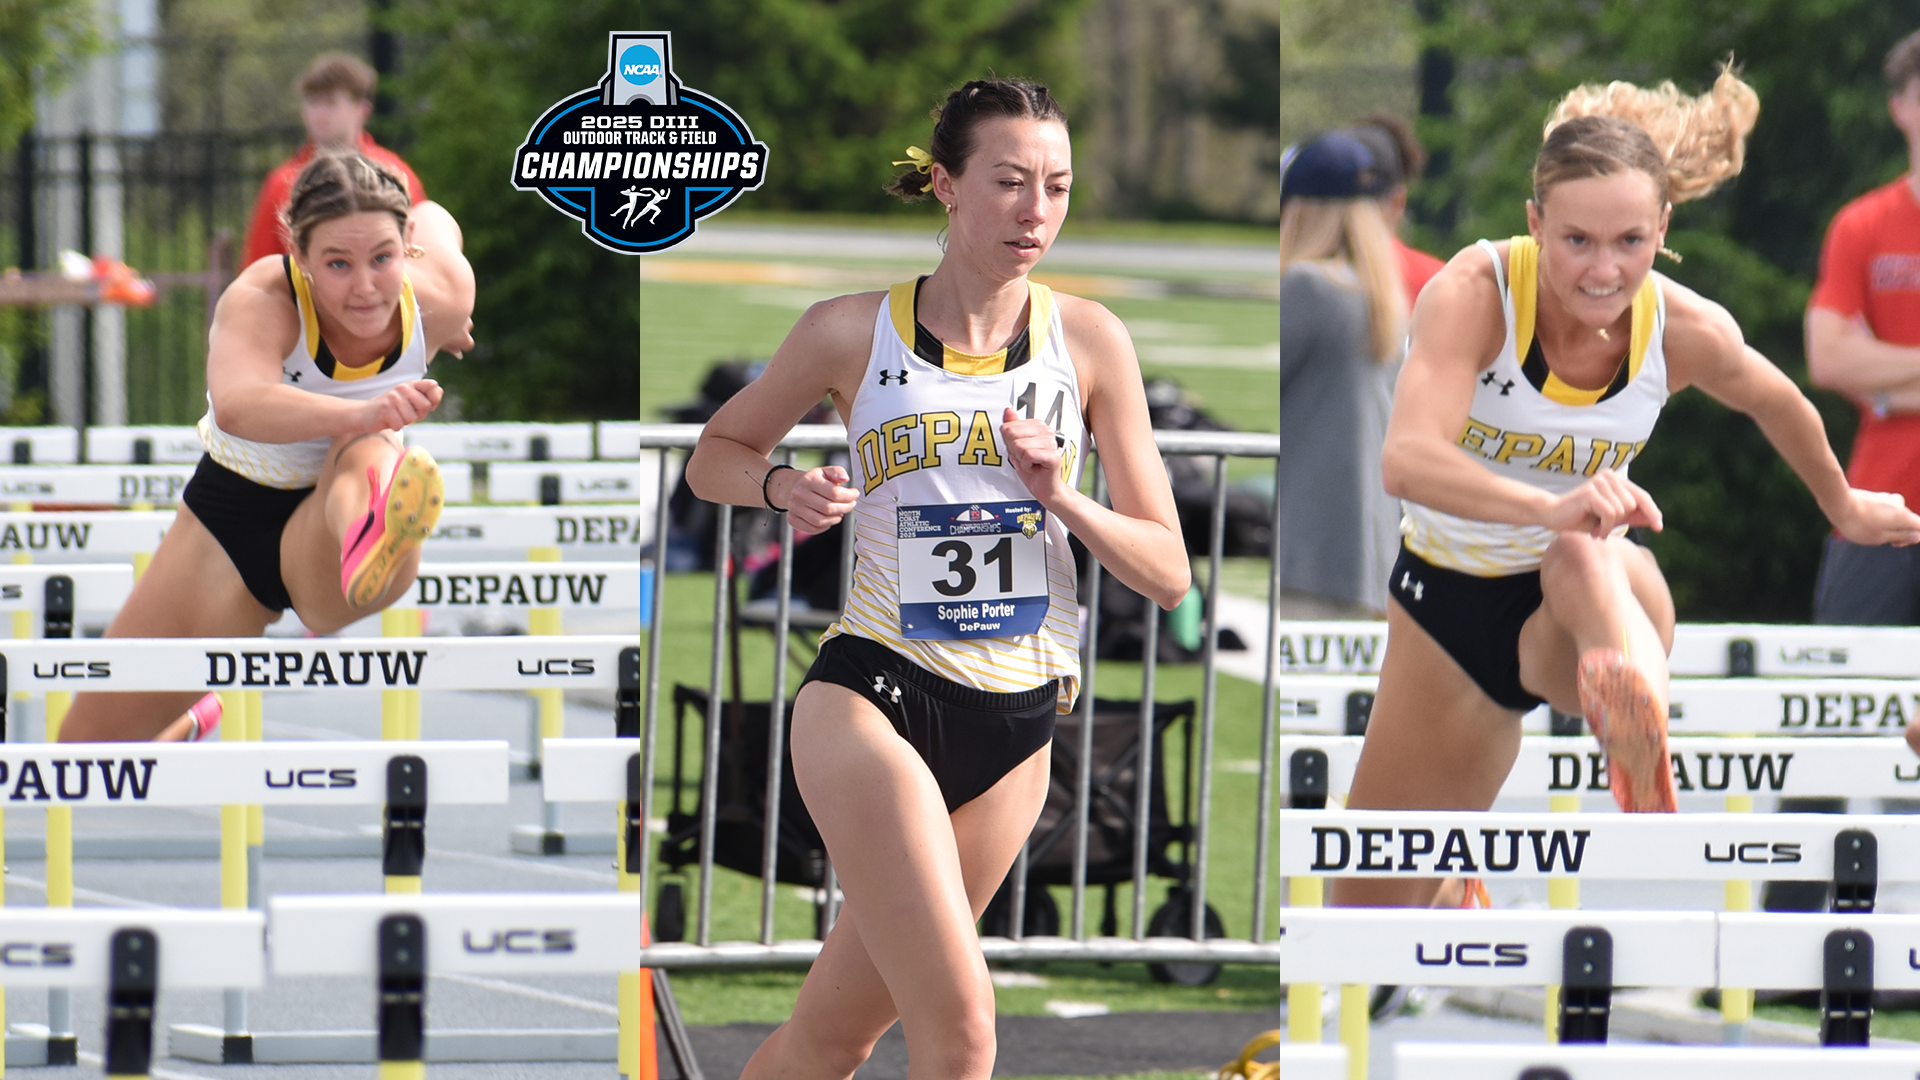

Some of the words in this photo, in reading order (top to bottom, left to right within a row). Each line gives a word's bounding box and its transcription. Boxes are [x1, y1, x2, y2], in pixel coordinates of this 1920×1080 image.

[1017, 382, 1065, 448] 14
[857, 410, 1077, 497] DEPAW
[1454, 418, 1646, 477] EPAU
[119, 475, 185, 499] DEP
[0, 522, 92, 549] AUW
[898, 525, 942, 533] CONFERENCE
[949, 522, 1002, 535] CHAMPIONSHIPS
[931, 537, 1013, 597] 31
[416, 574, 607, 605] DEPAUW
[937, 604, 979, 623] Sophie
[981, 602, 1016, 618] Porter
[959, 622, 1001, 632] DePauw
[1280, 634, 1381, 667] AUW
[1780, 646, 1848, 664] UCS
[33, 660, 112, 679] UCS
[205, 650, 428, 687] DEPAUW
[517, 658, 596, 677] UCS
[1780, 692, 1920, 728] DEPA
[0, 758, 157, 801] AUW
[265, 767, 357, 789] UCS
[1548, 751, 1794, 791] DEAUW
[1311, 825, 1591, 874] DEPAUW
[1703, 841, 1802, 865] UCS
[0, 943, 73, 967] CS
[462, 929, 577, 954] UCS
[1415, 942, 1529, 968] UCS
